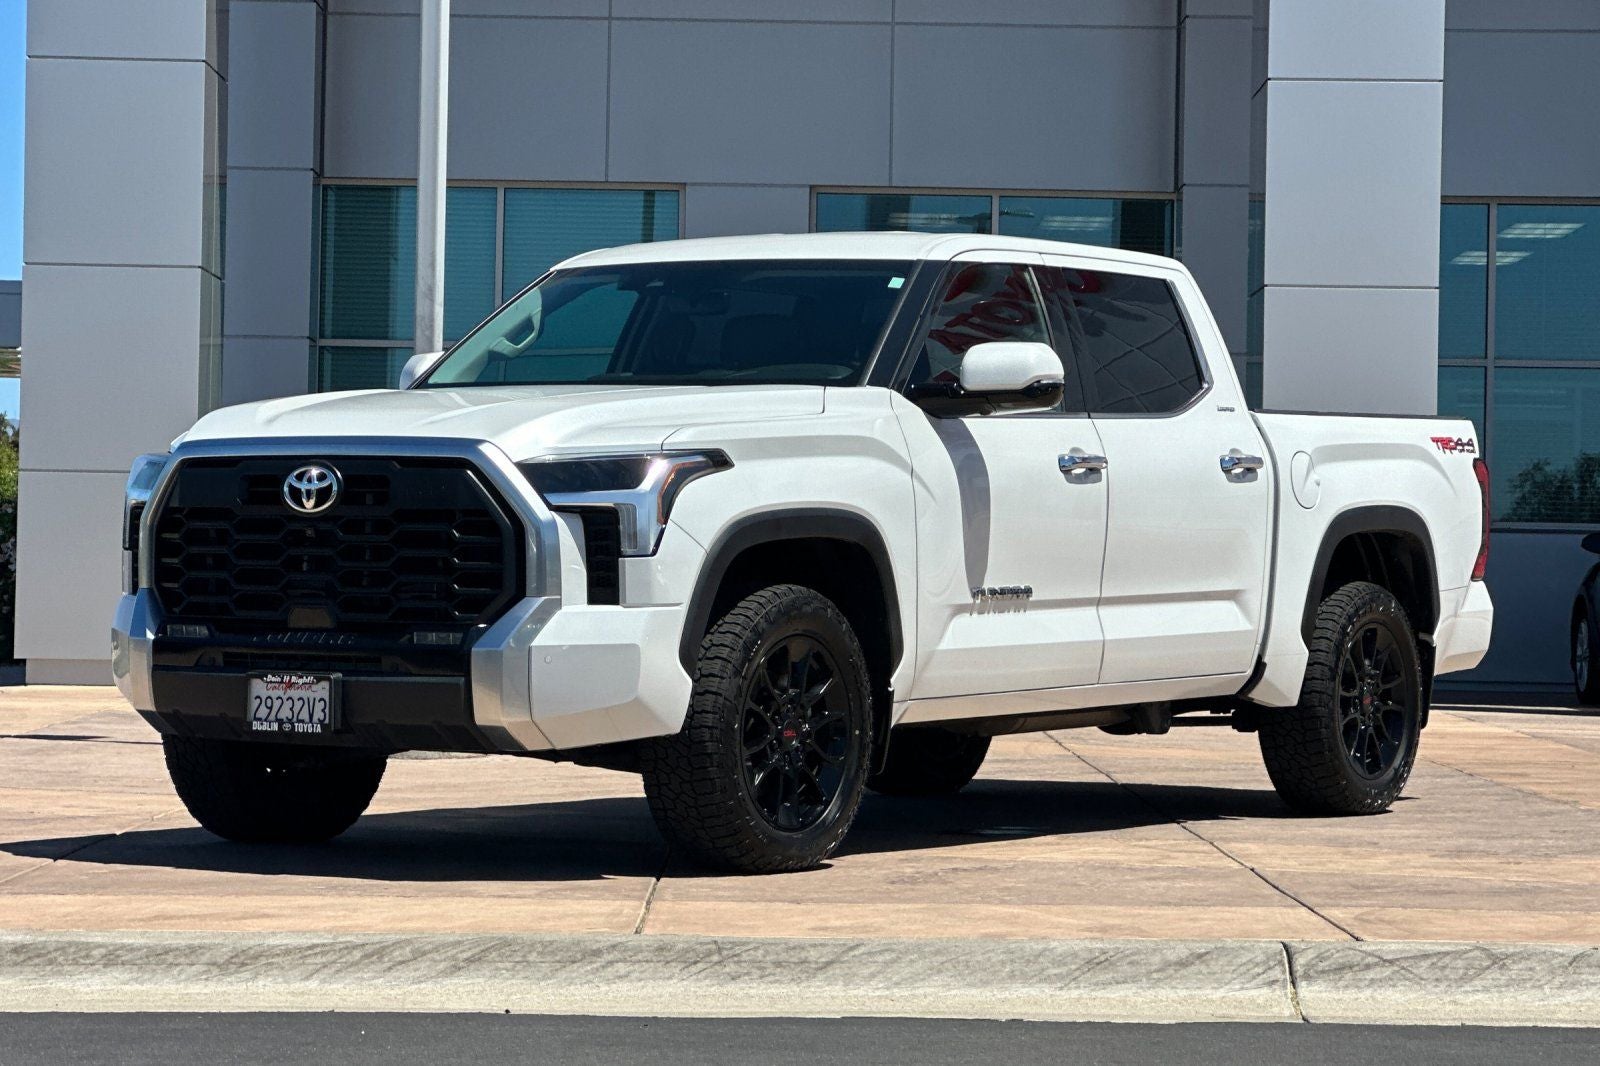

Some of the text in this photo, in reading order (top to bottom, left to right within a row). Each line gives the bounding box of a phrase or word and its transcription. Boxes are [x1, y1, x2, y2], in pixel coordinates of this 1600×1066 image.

[253, 695, 327, 723] 29232V3
[252, 721, 322, 733] DUBLIN TOYOTA
